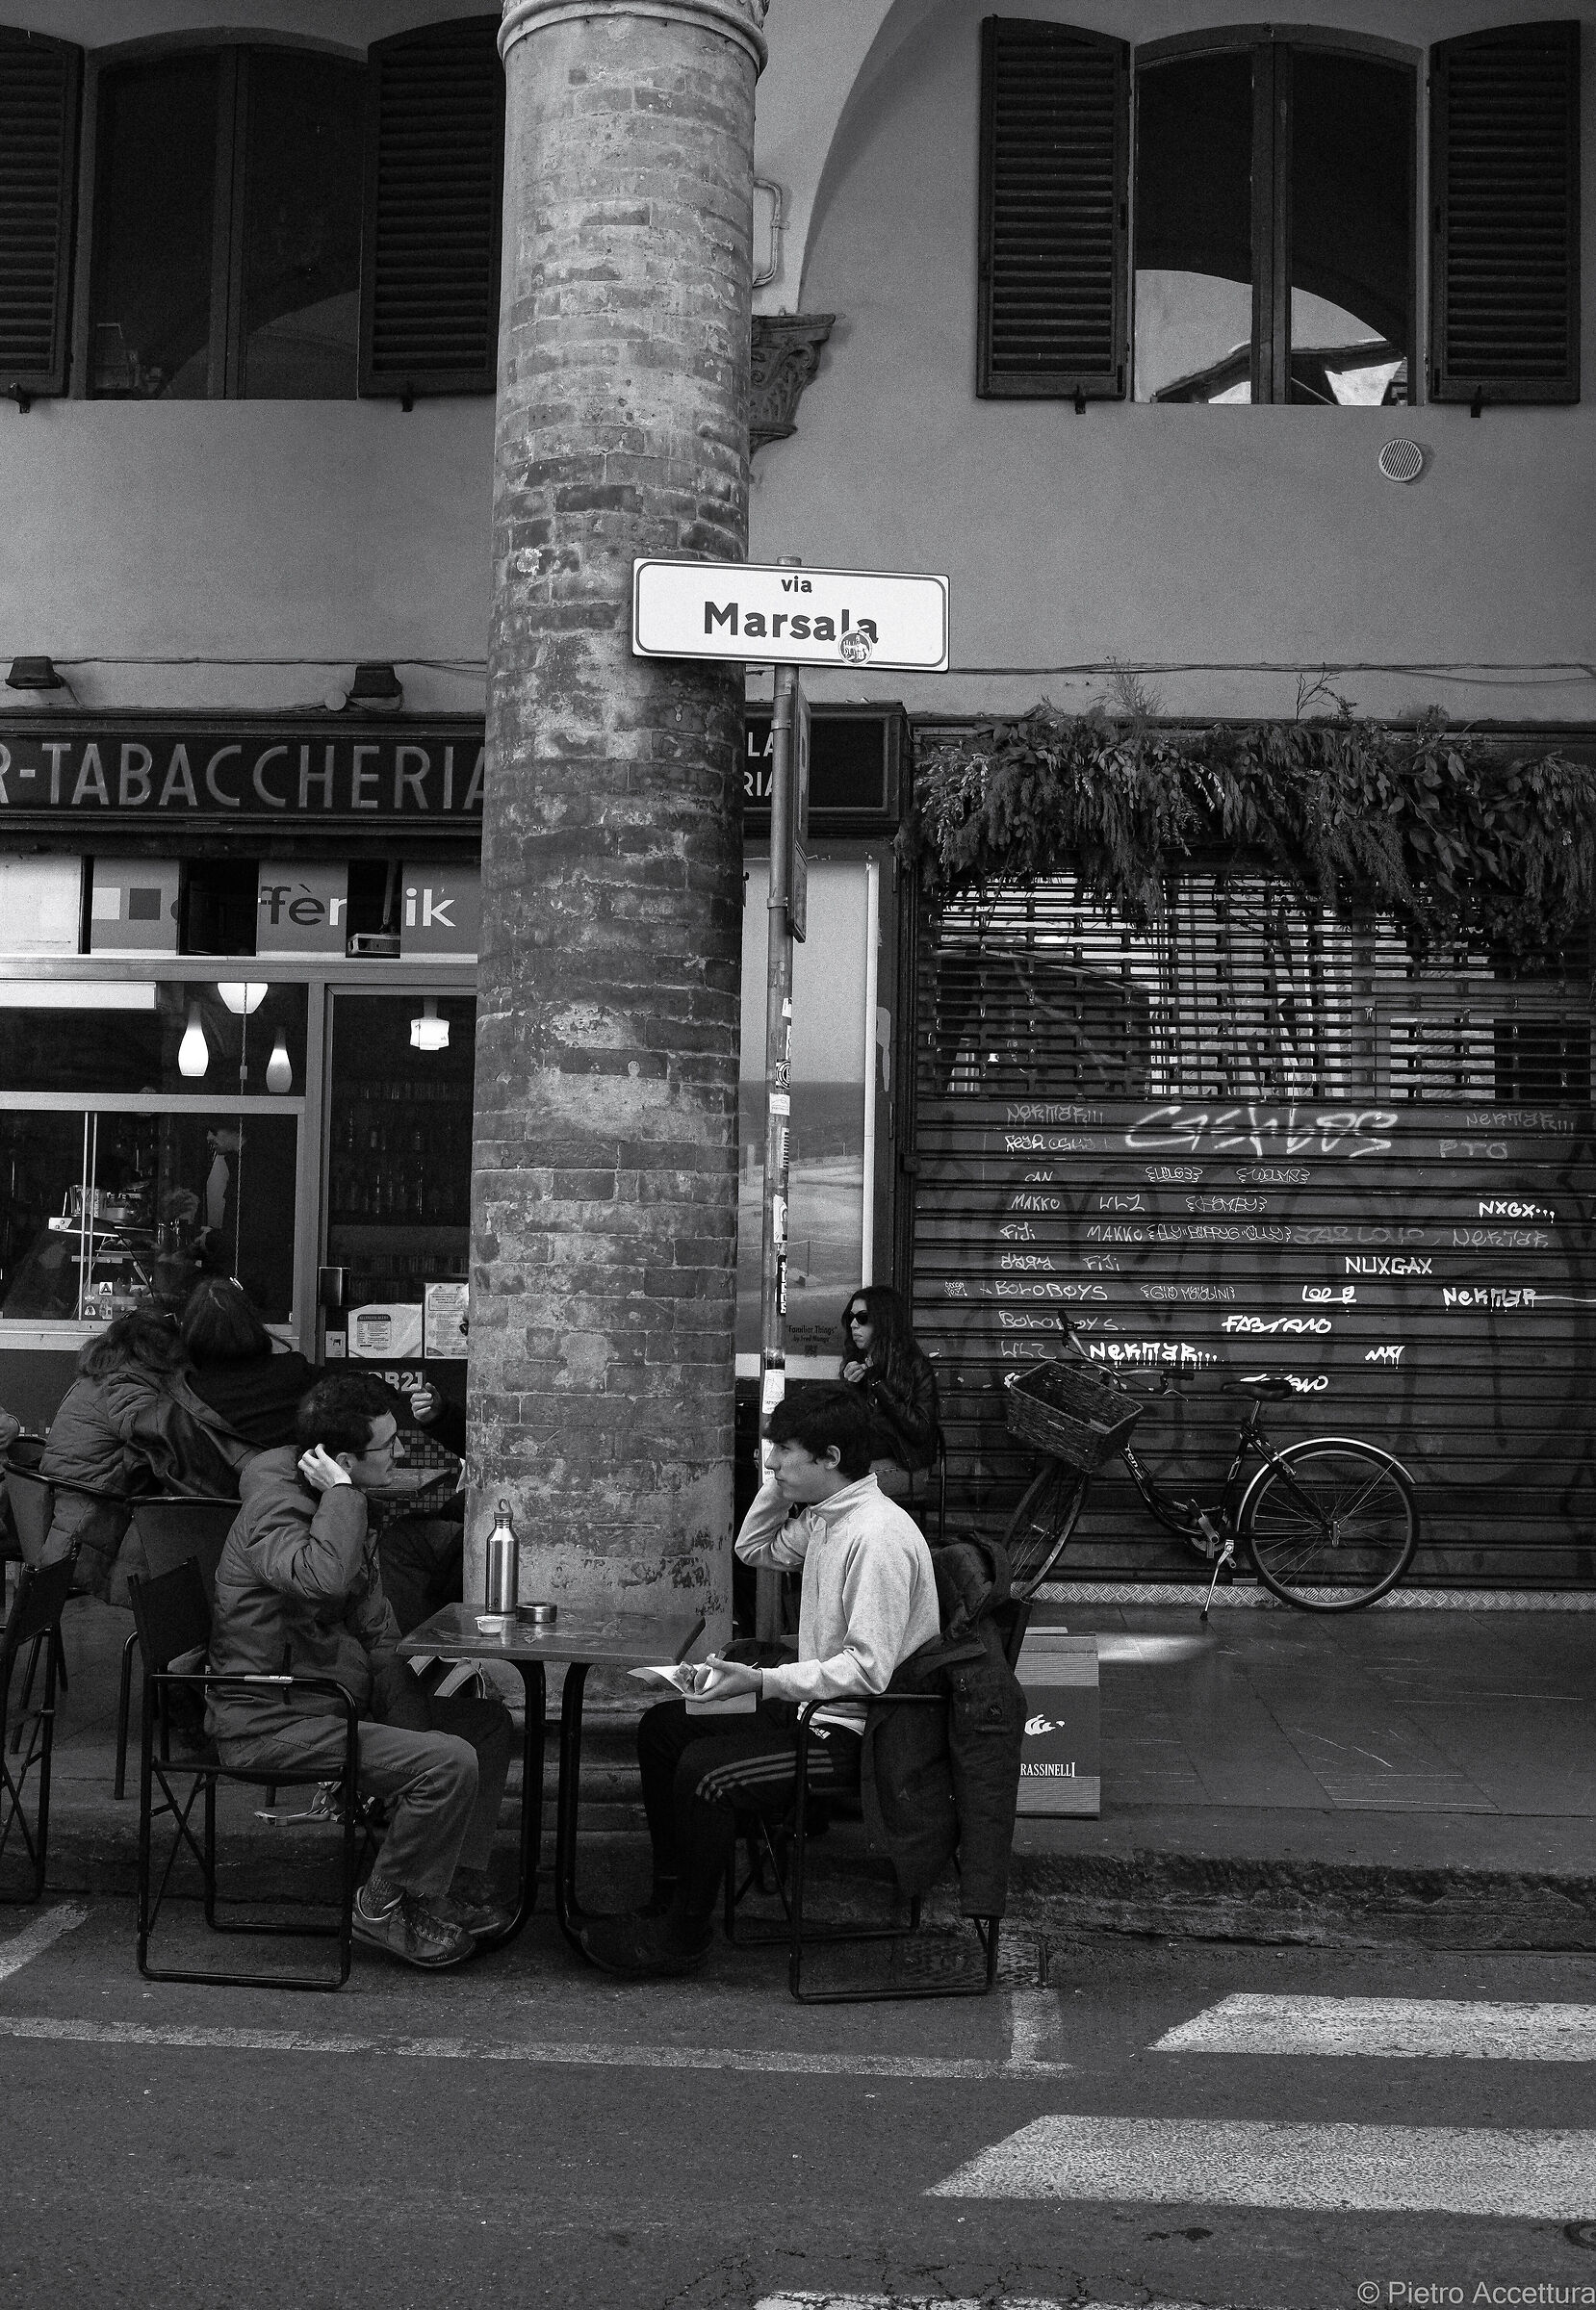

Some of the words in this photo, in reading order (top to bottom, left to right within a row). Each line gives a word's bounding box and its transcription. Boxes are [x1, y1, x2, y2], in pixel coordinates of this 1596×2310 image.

[781, 576, 812, 593] via
[705, 602, 879, 643] Marsala
[1346, 1257, 1433, 1275] NUXGAX
